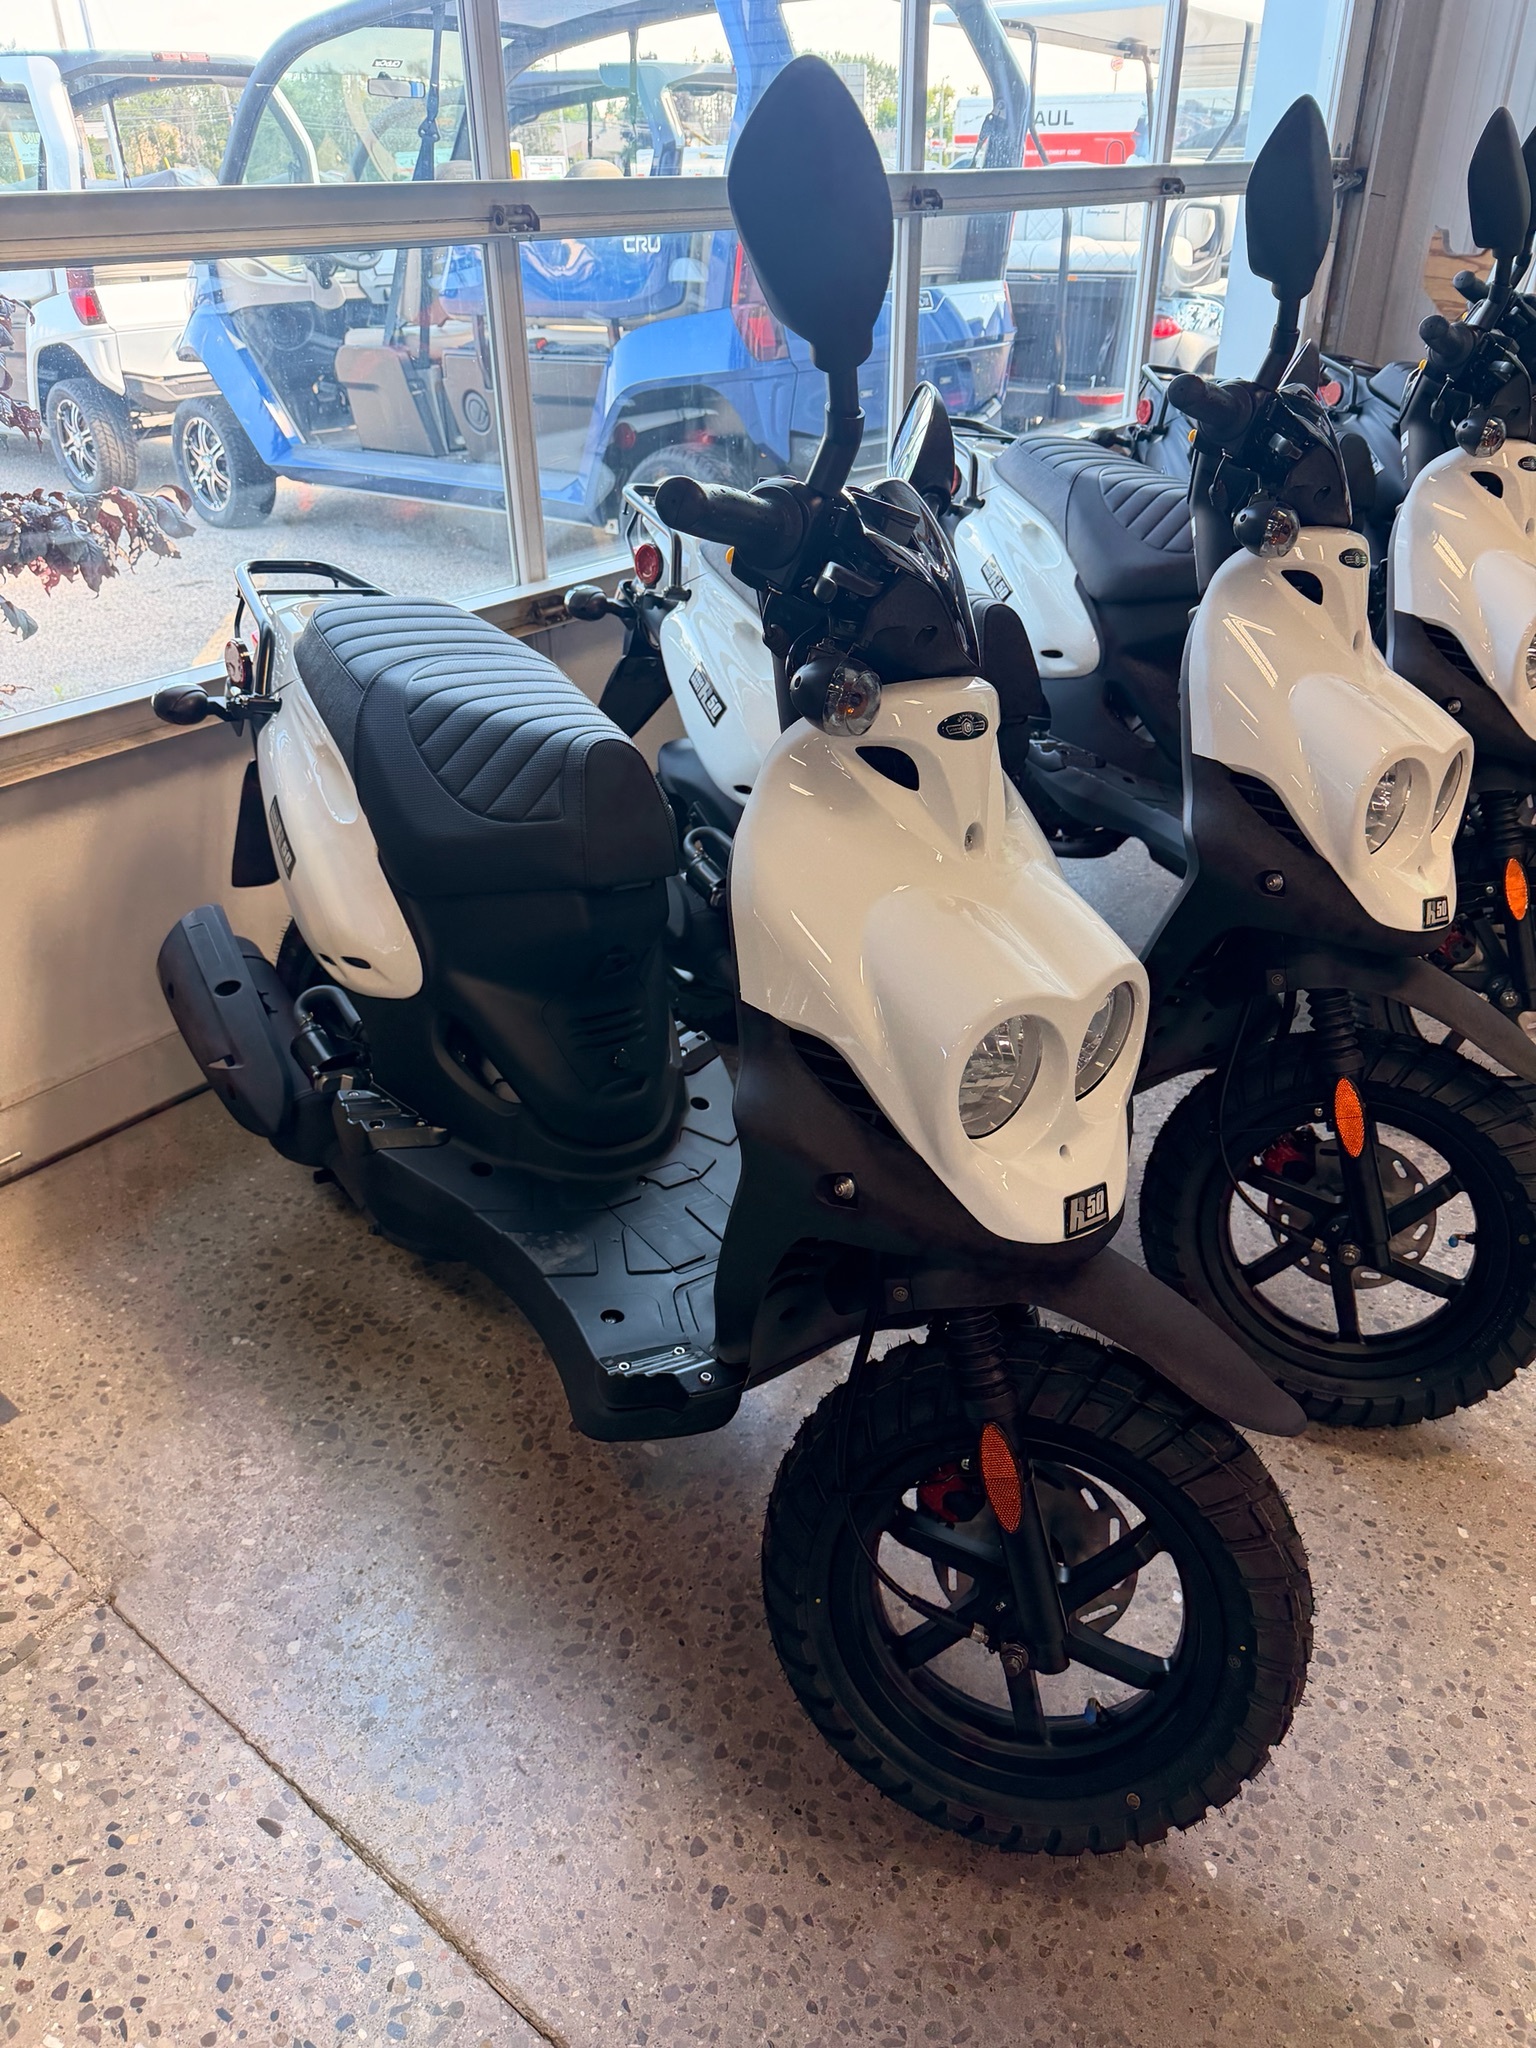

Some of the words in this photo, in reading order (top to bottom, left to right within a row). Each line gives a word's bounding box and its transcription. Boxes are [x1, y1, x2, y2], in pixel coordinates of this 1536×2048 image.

[1034, 109, 1074, 127] AUL
[623, 235, 661, 254] CRU
[1069, 1190, 1107, 1234] R50
